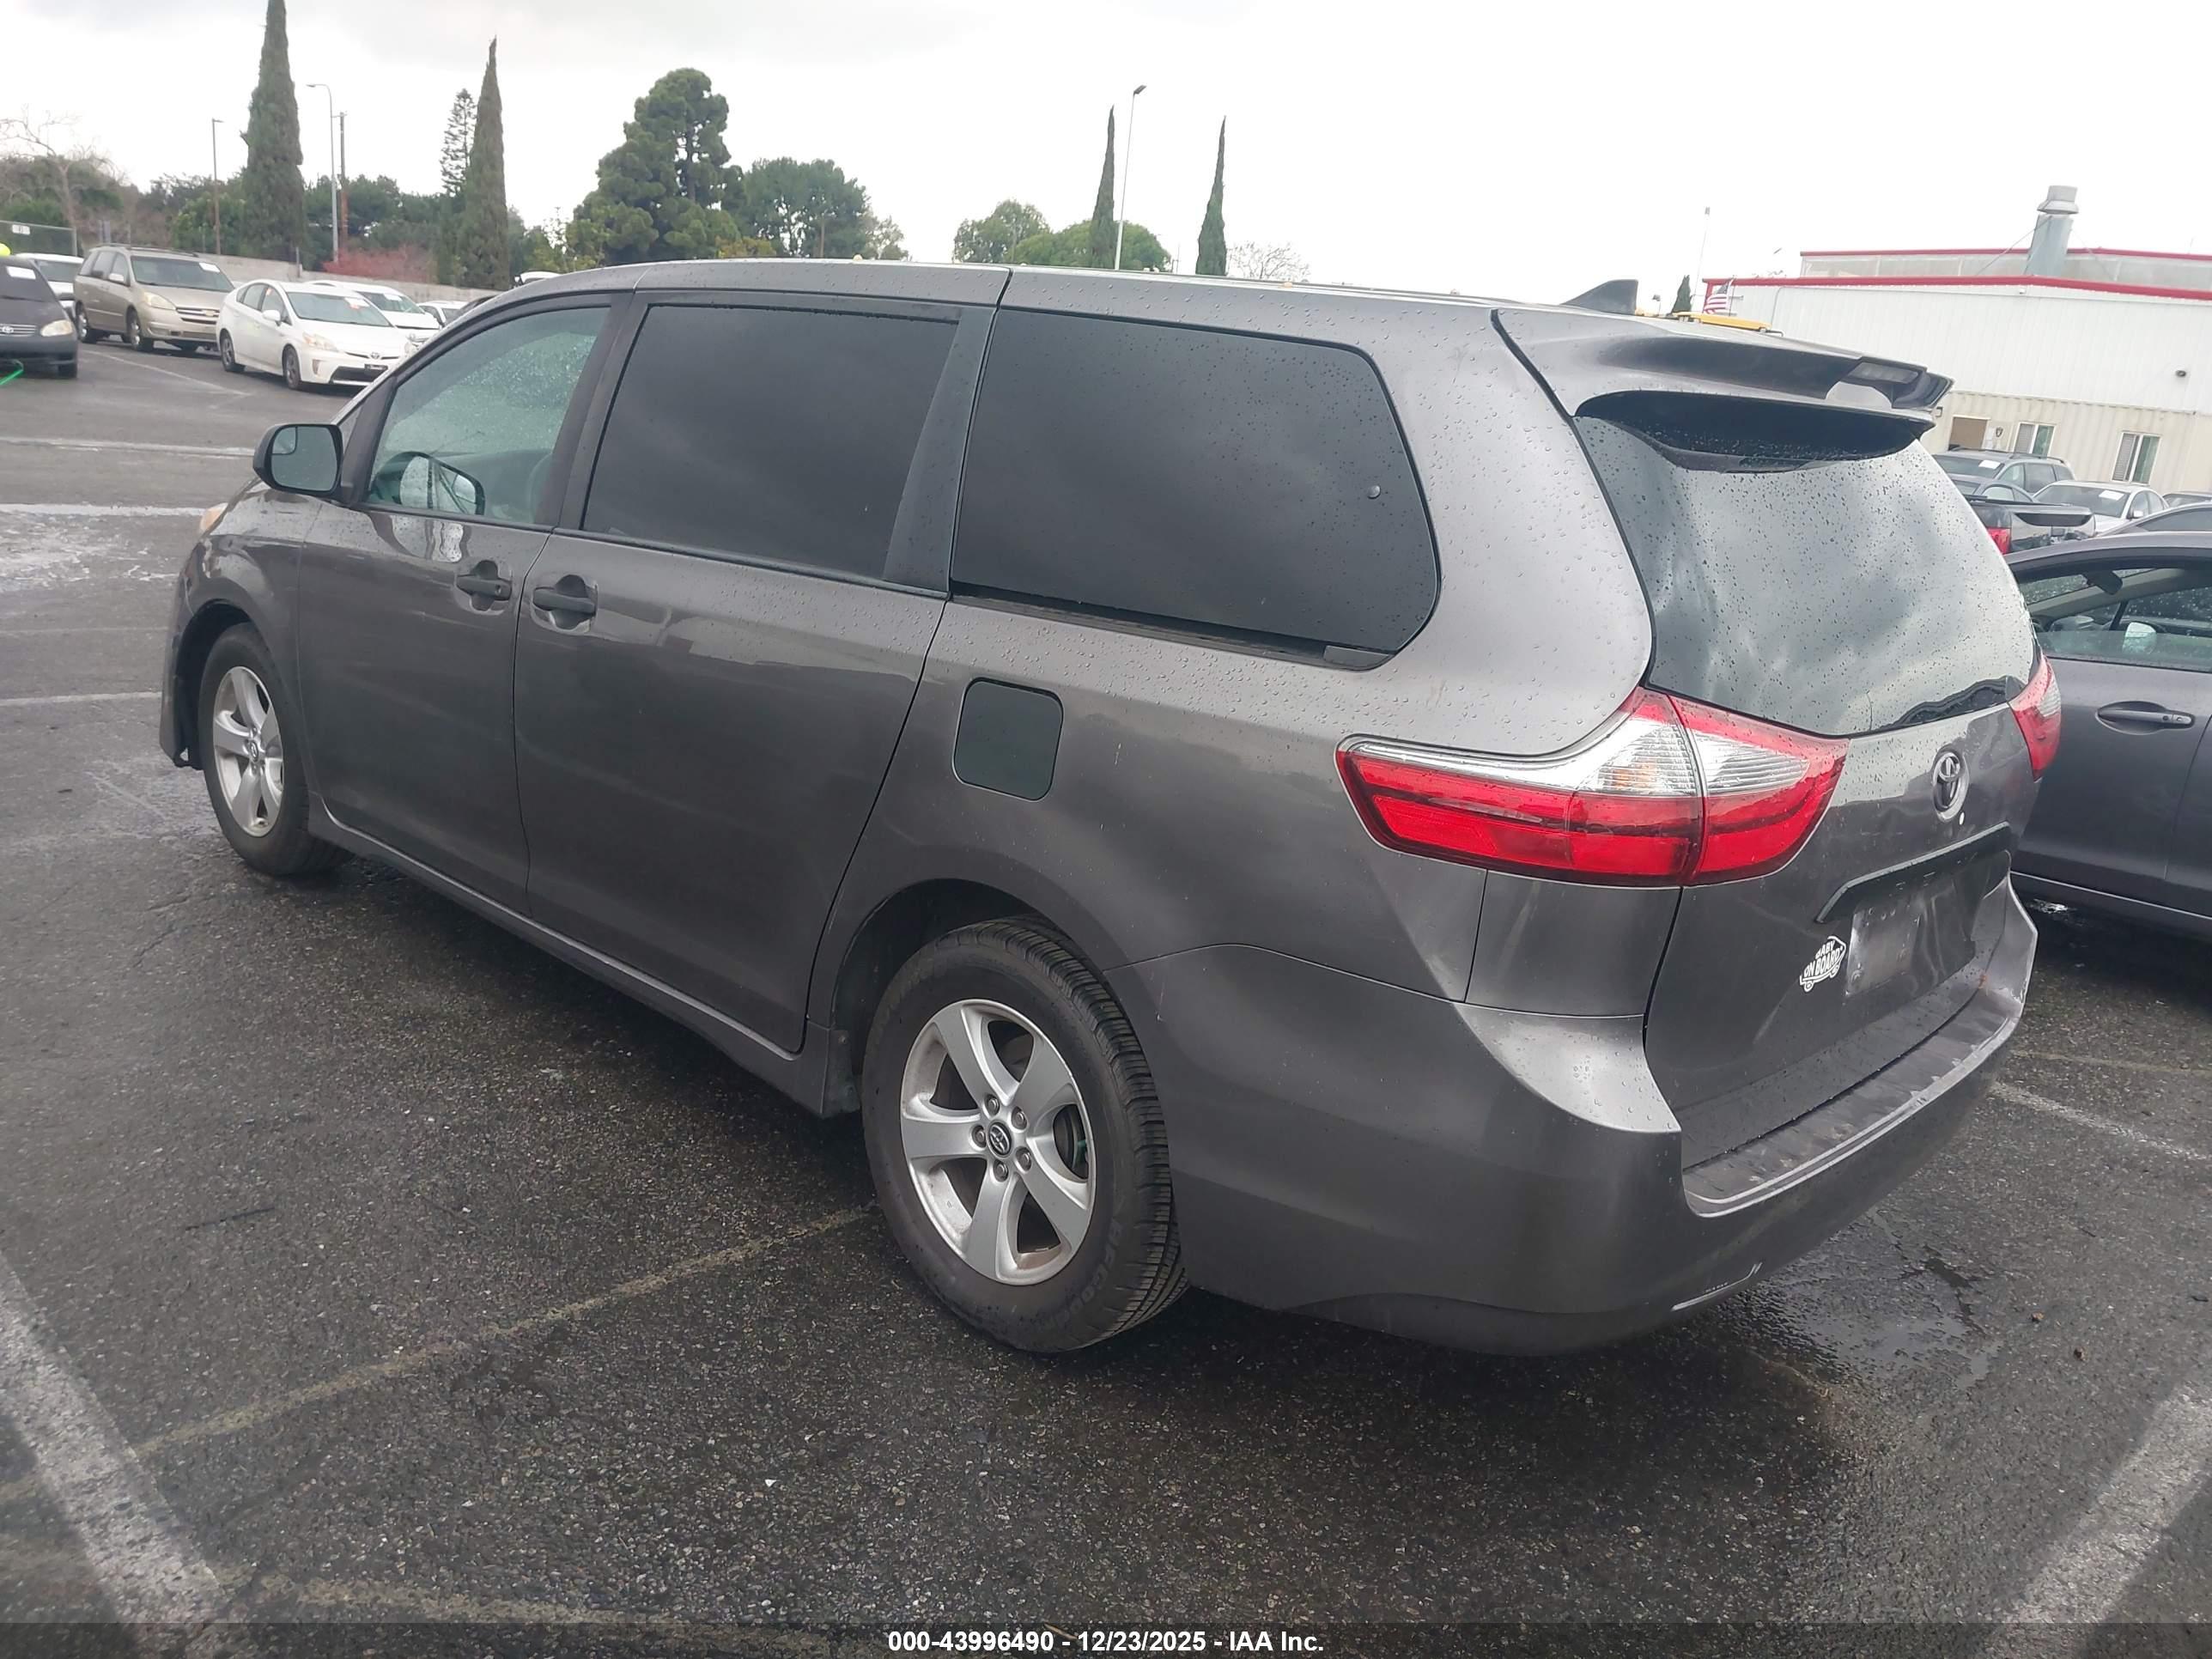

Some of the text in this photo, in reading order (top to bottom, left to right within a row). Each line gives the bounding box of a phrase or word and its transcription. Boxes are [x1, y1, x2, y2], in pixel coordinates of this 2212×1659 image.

[1815, 940, 1835, 959] BABY
[1804, 948, 1840, 977] ON BOARD
